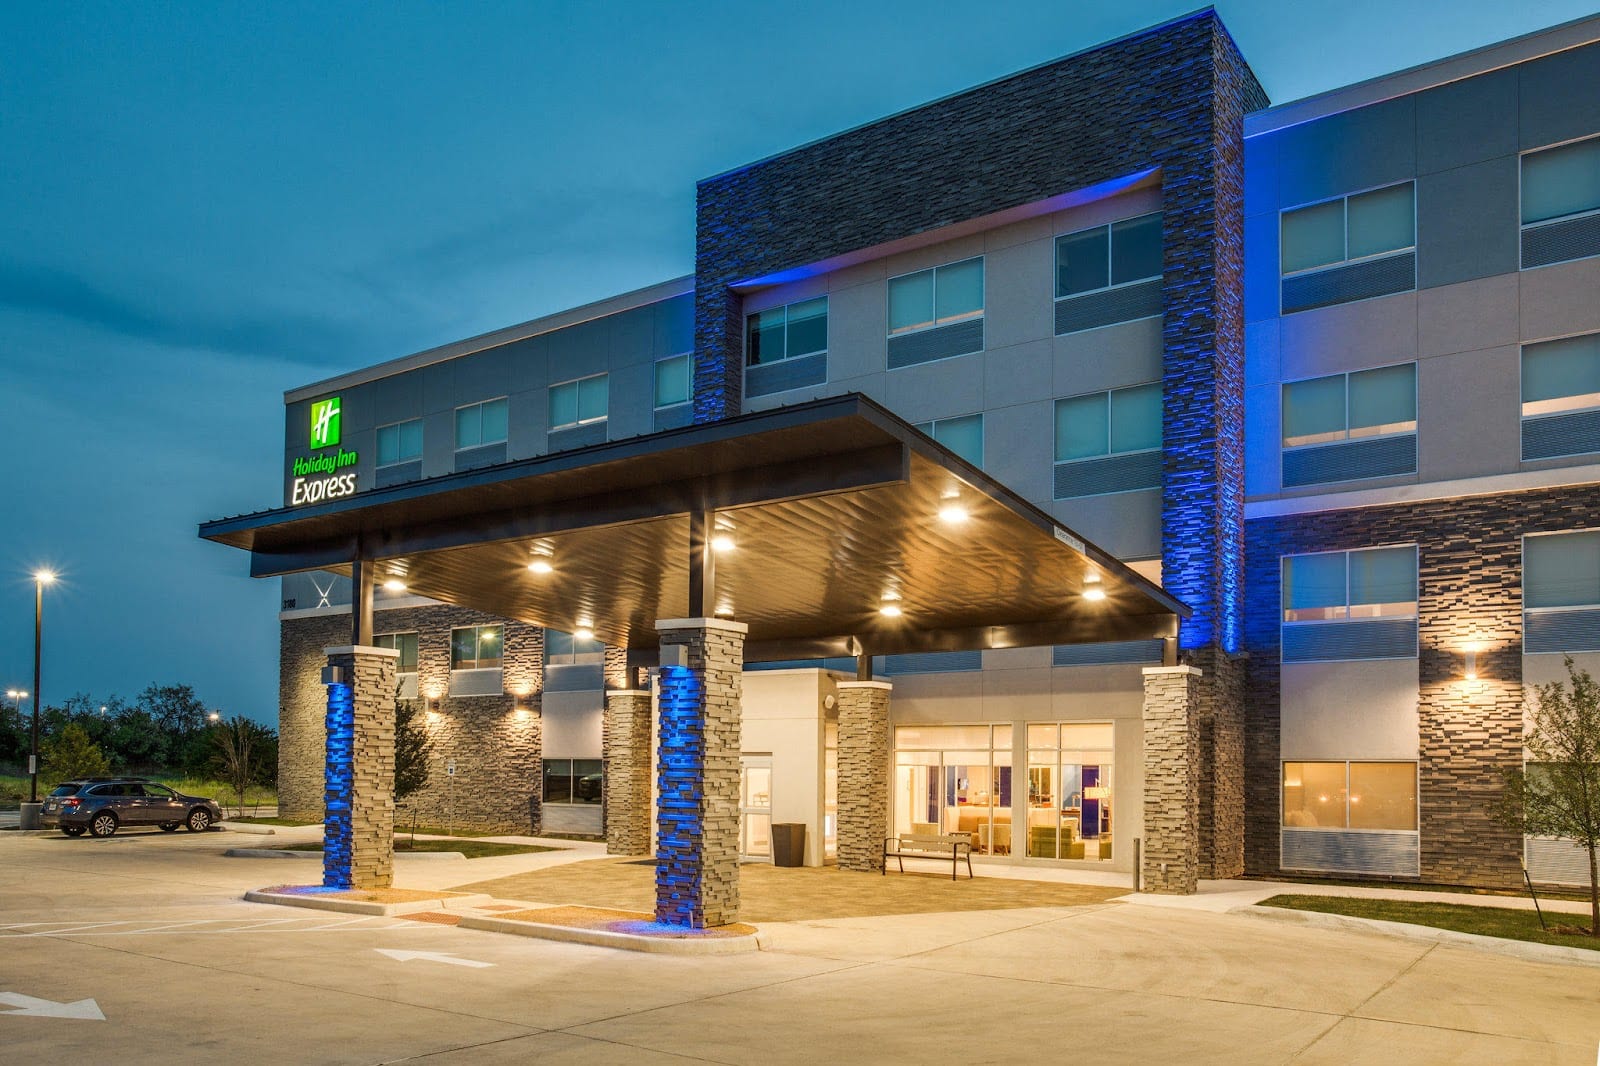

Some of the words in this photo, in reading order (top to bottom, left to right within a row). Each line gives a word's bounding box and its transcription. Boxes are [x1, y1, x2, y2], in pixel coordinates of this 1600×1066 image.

[293, 453, 337, 477] Holiday
[337, 448, 357, 468] Inn
[292, 473, 356, 505] Express
